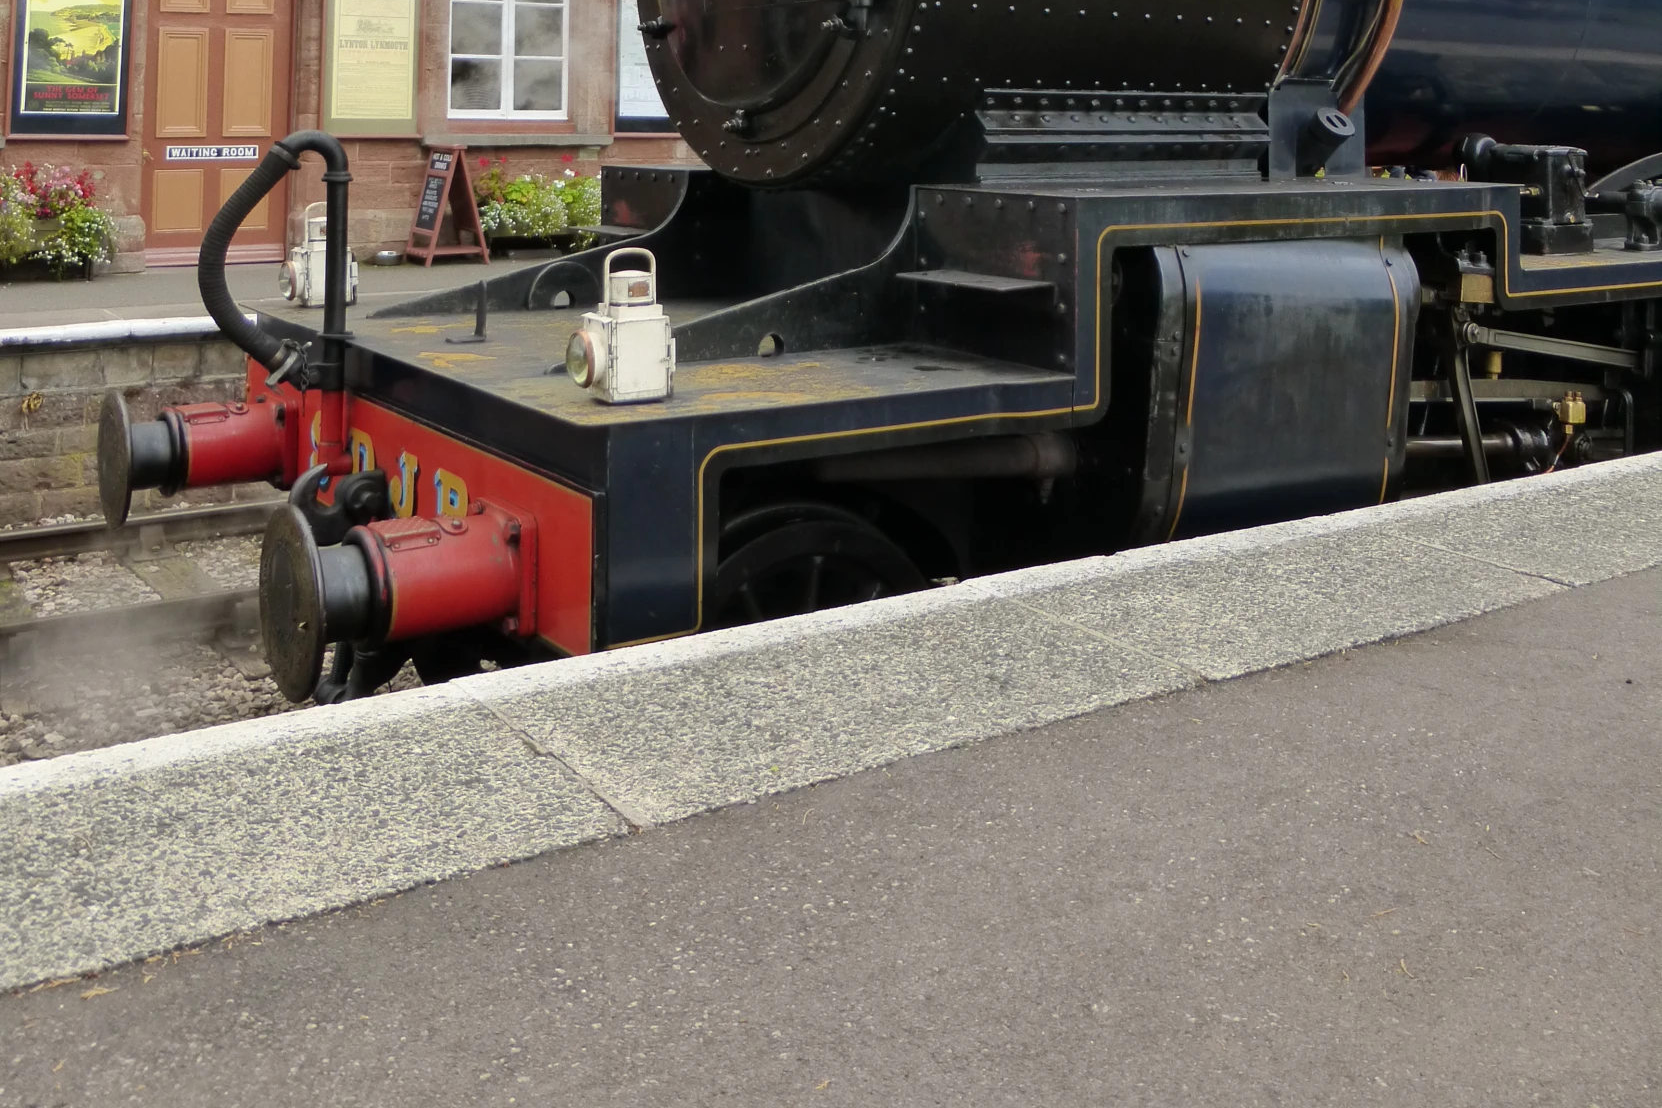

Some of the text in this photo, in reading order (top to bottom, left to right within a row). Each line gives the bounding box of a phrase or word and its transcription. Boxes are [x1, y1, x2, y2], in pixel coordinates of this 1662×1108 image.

[46, 85, 62, 93] THE
[67, 92, 109, 100] SOMERSET
[171, 147, 254, 157] WAITING ROOM
